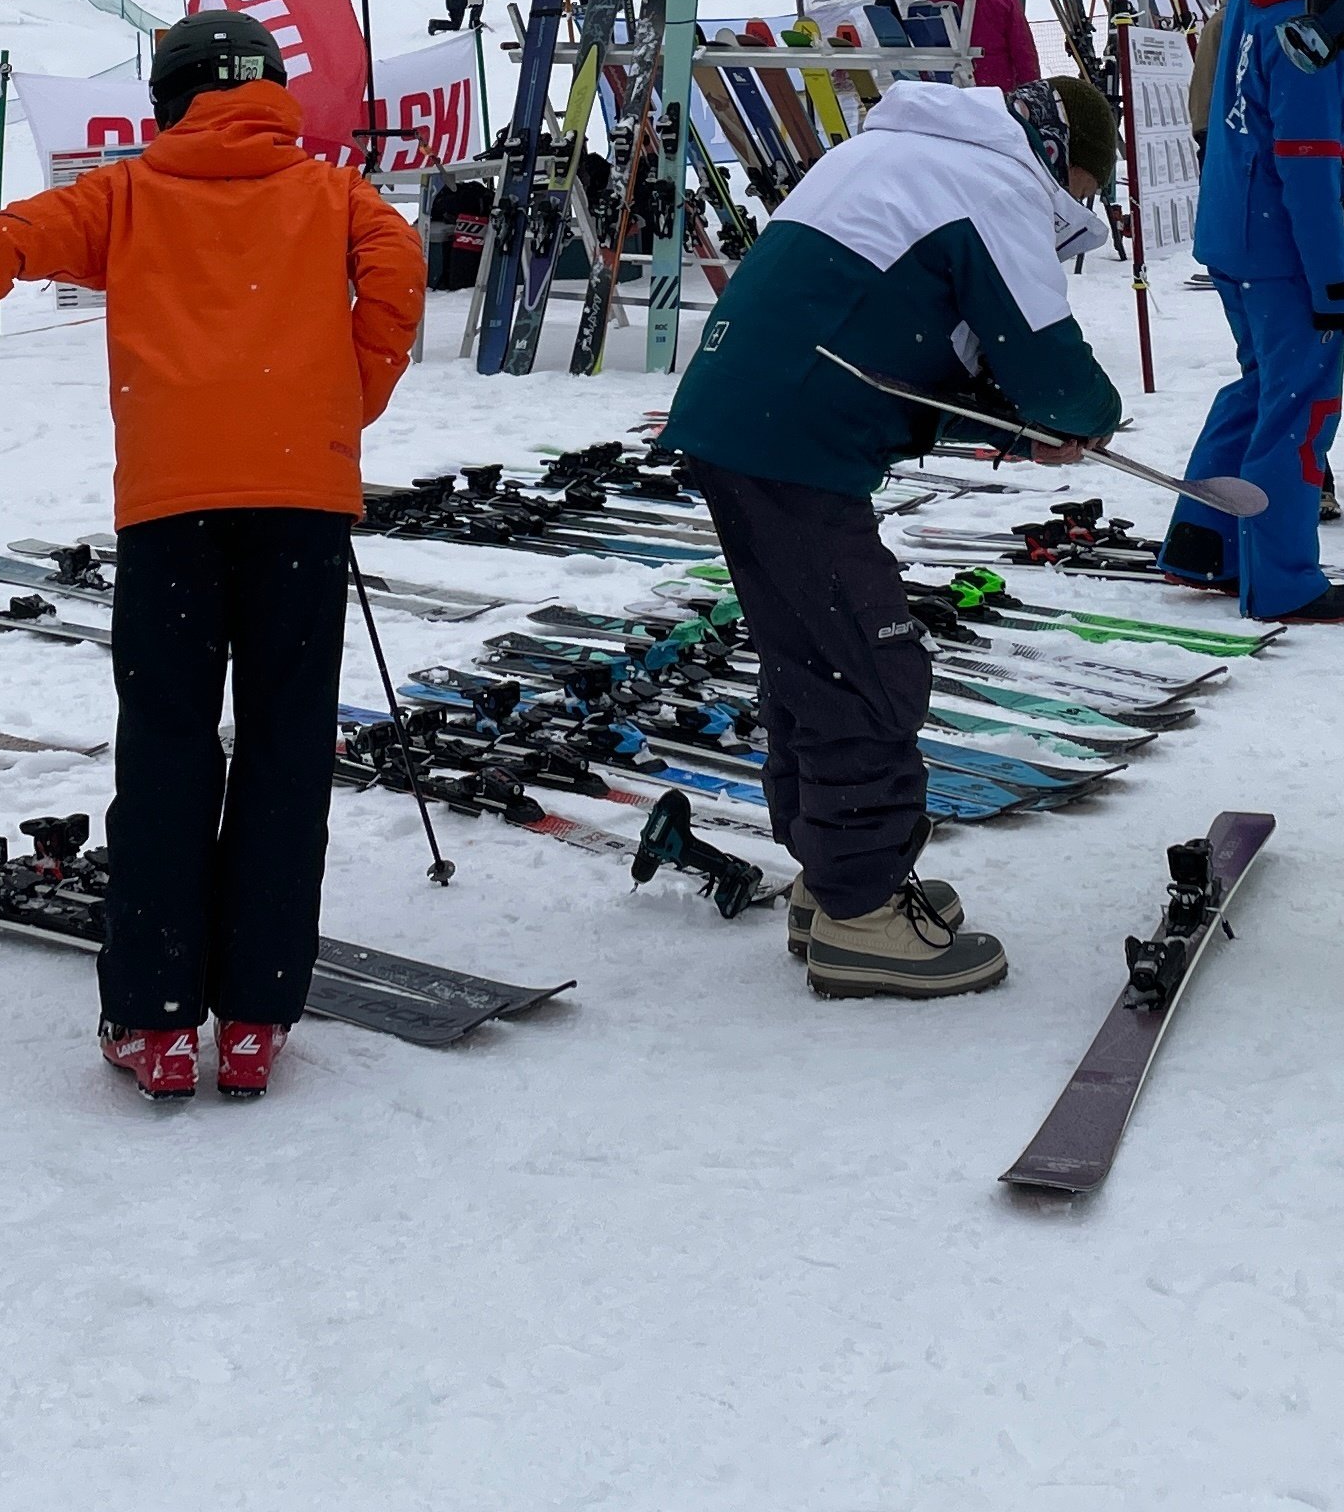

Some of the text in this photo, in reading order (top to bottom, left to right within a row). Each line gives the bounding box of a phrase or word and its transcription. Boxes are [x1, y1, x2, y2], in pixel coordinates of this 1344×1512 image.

[390, 78, 471, 172] SKI
[878, 621, 914, 639] elan
[116, 1038, 146, 1059] LANGE
